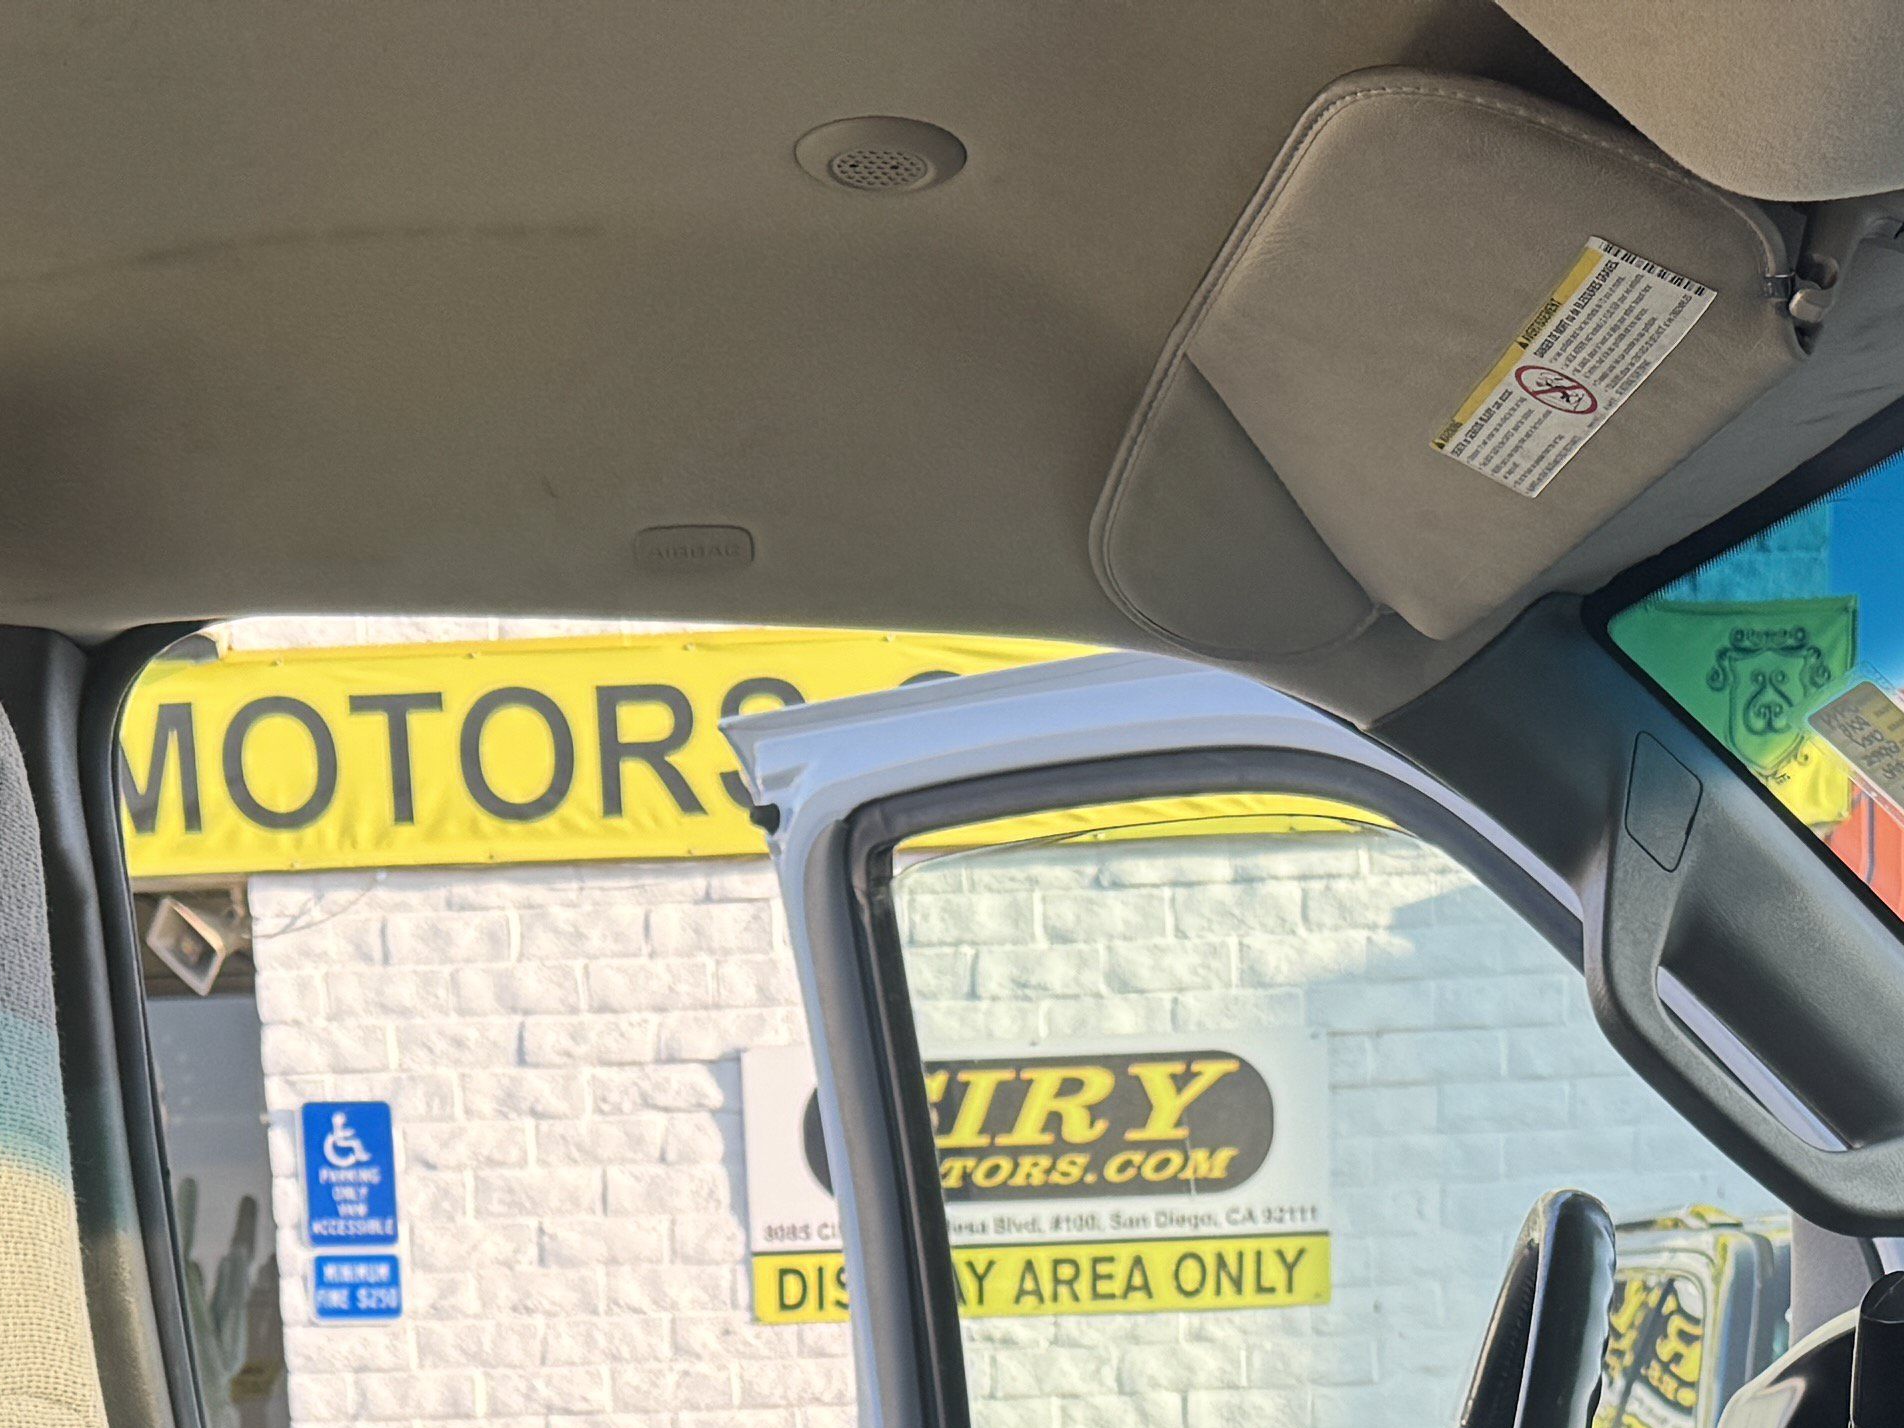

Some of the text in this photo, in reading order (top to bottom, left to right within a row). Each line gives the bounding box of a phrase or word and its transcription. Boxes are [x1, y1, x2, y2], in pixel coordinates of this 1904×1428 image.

[925, 1058, 1240, 1149] IRY
[939, 1147, 1240, 1189] TORS.COM
[312, 1218, 395, 1236] ACCESSIBLE
[1226, 1207, 1255, 1226] CA
[1013, 1253, 1154, 1305] AREA
[1173, 1246, 1307, 1298] ONLY
